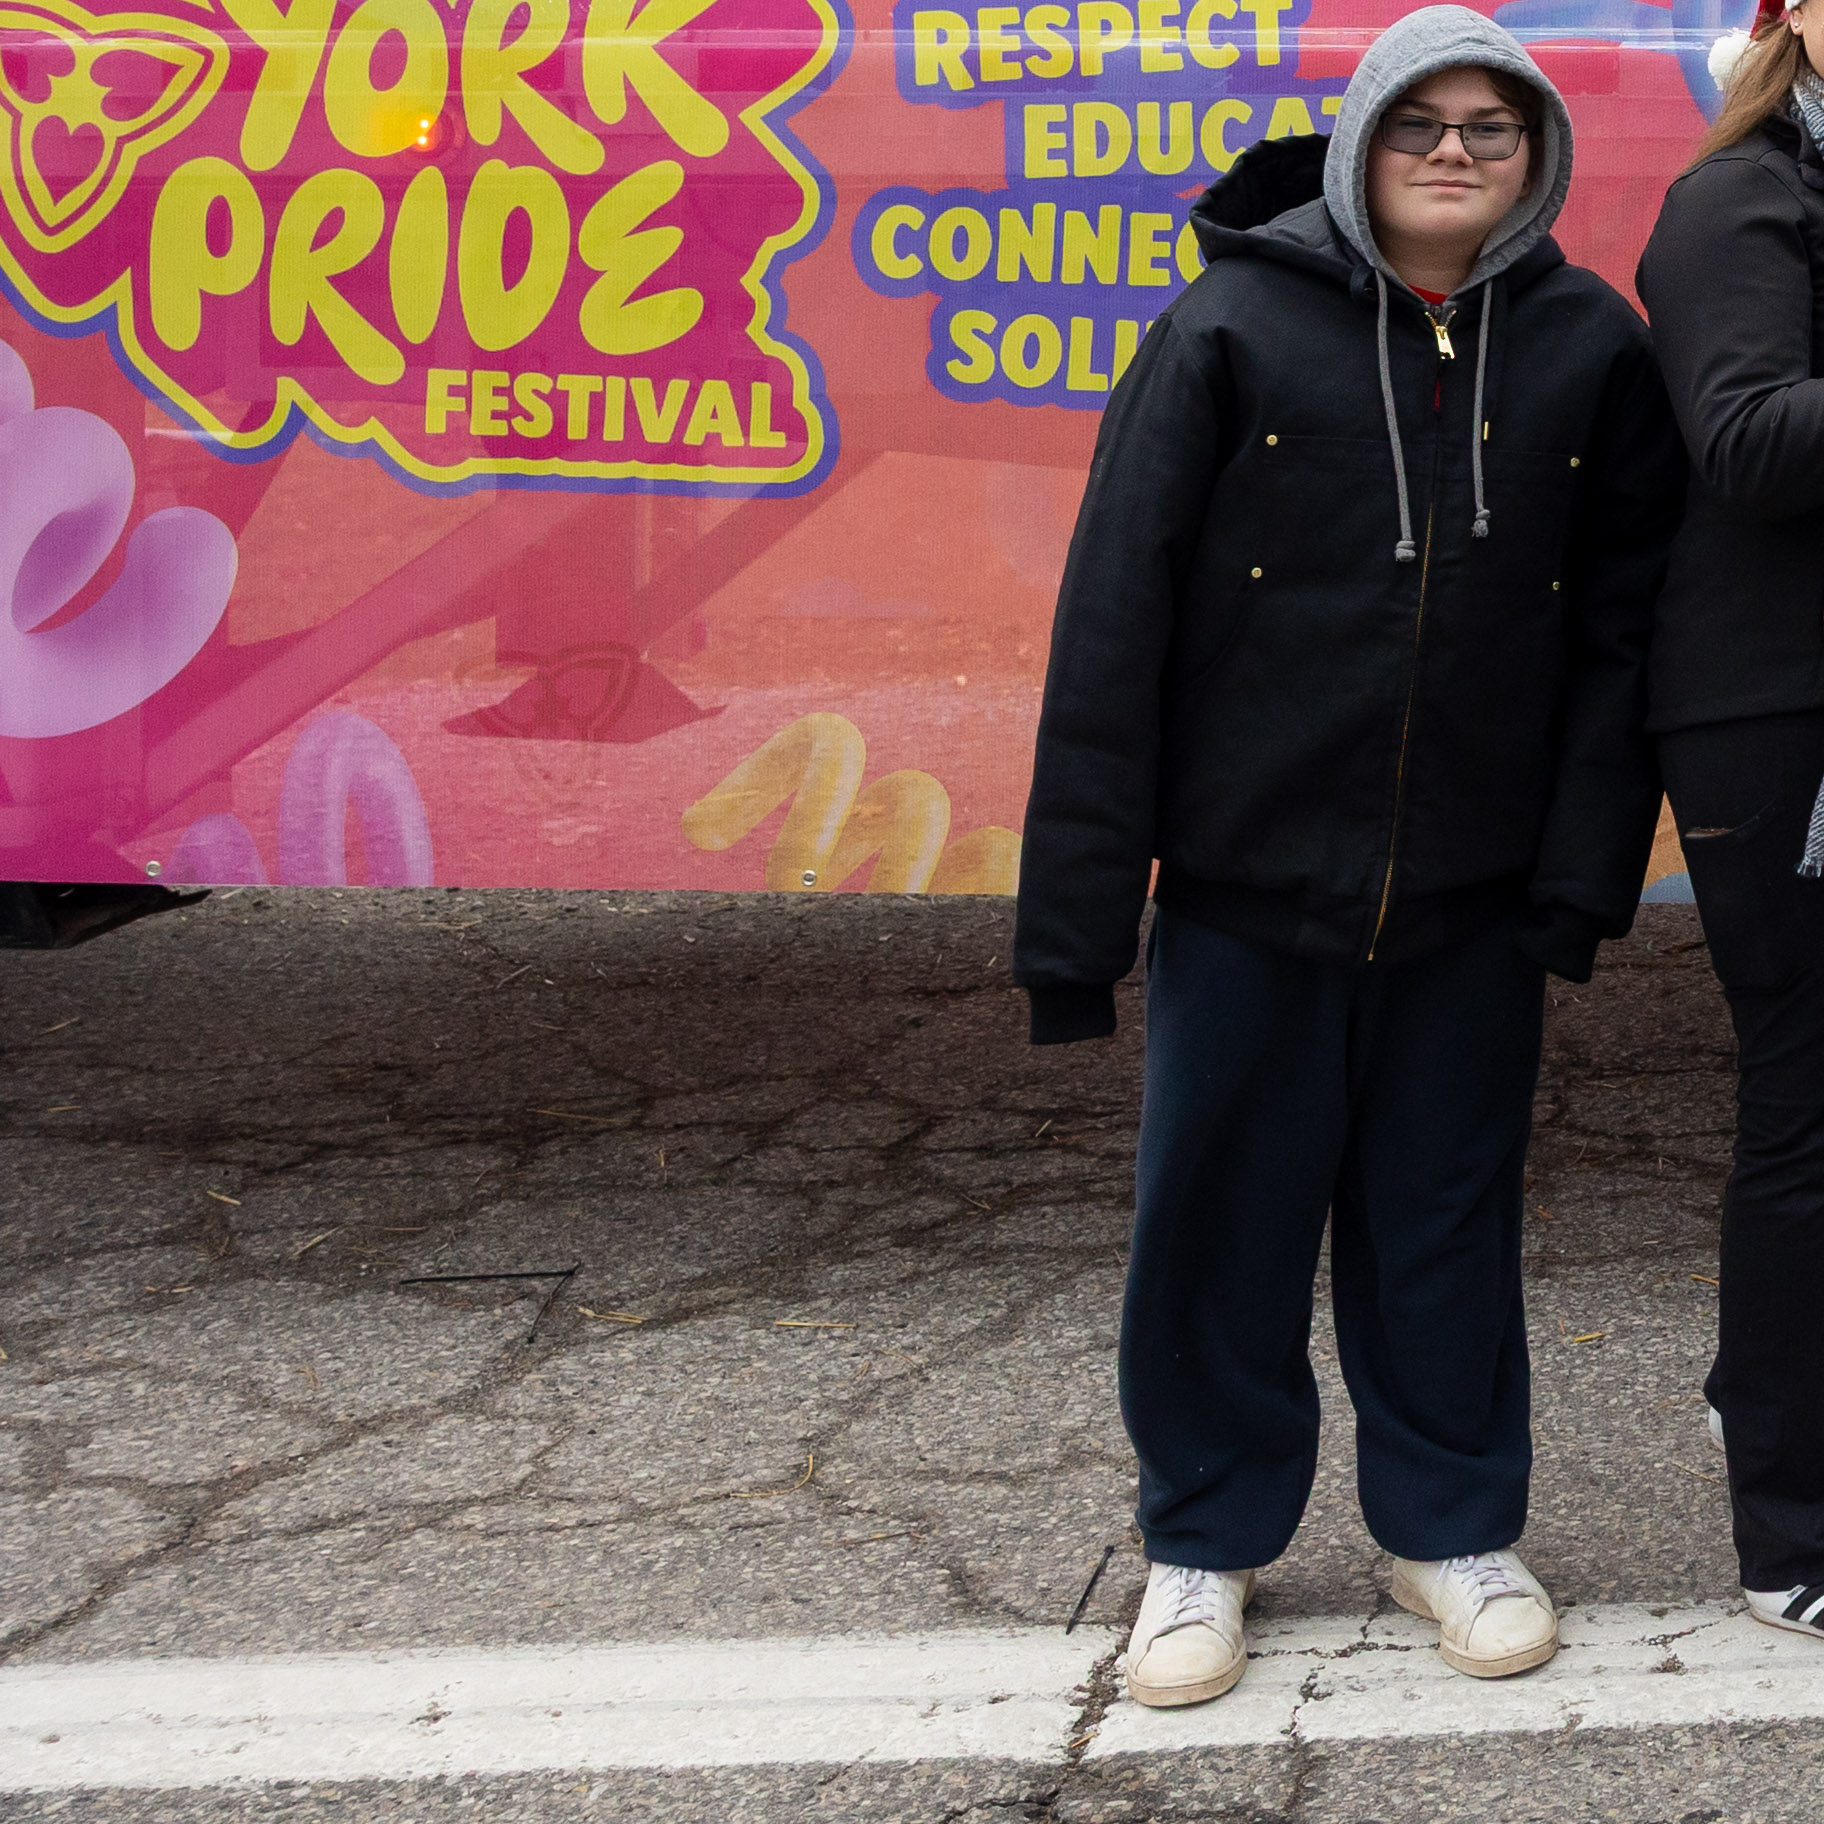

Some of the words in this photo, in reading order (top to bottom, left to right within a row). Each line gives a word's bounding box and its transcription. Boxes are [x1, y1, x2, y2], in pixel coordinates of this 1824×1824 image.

[1023, 96, 1342, 178] EDUCA
[149, 156, 706, 386] PRIDE
[945, 308, 1156, 392] SOLI
[424, 368, 787, 450] FESTIVAL
